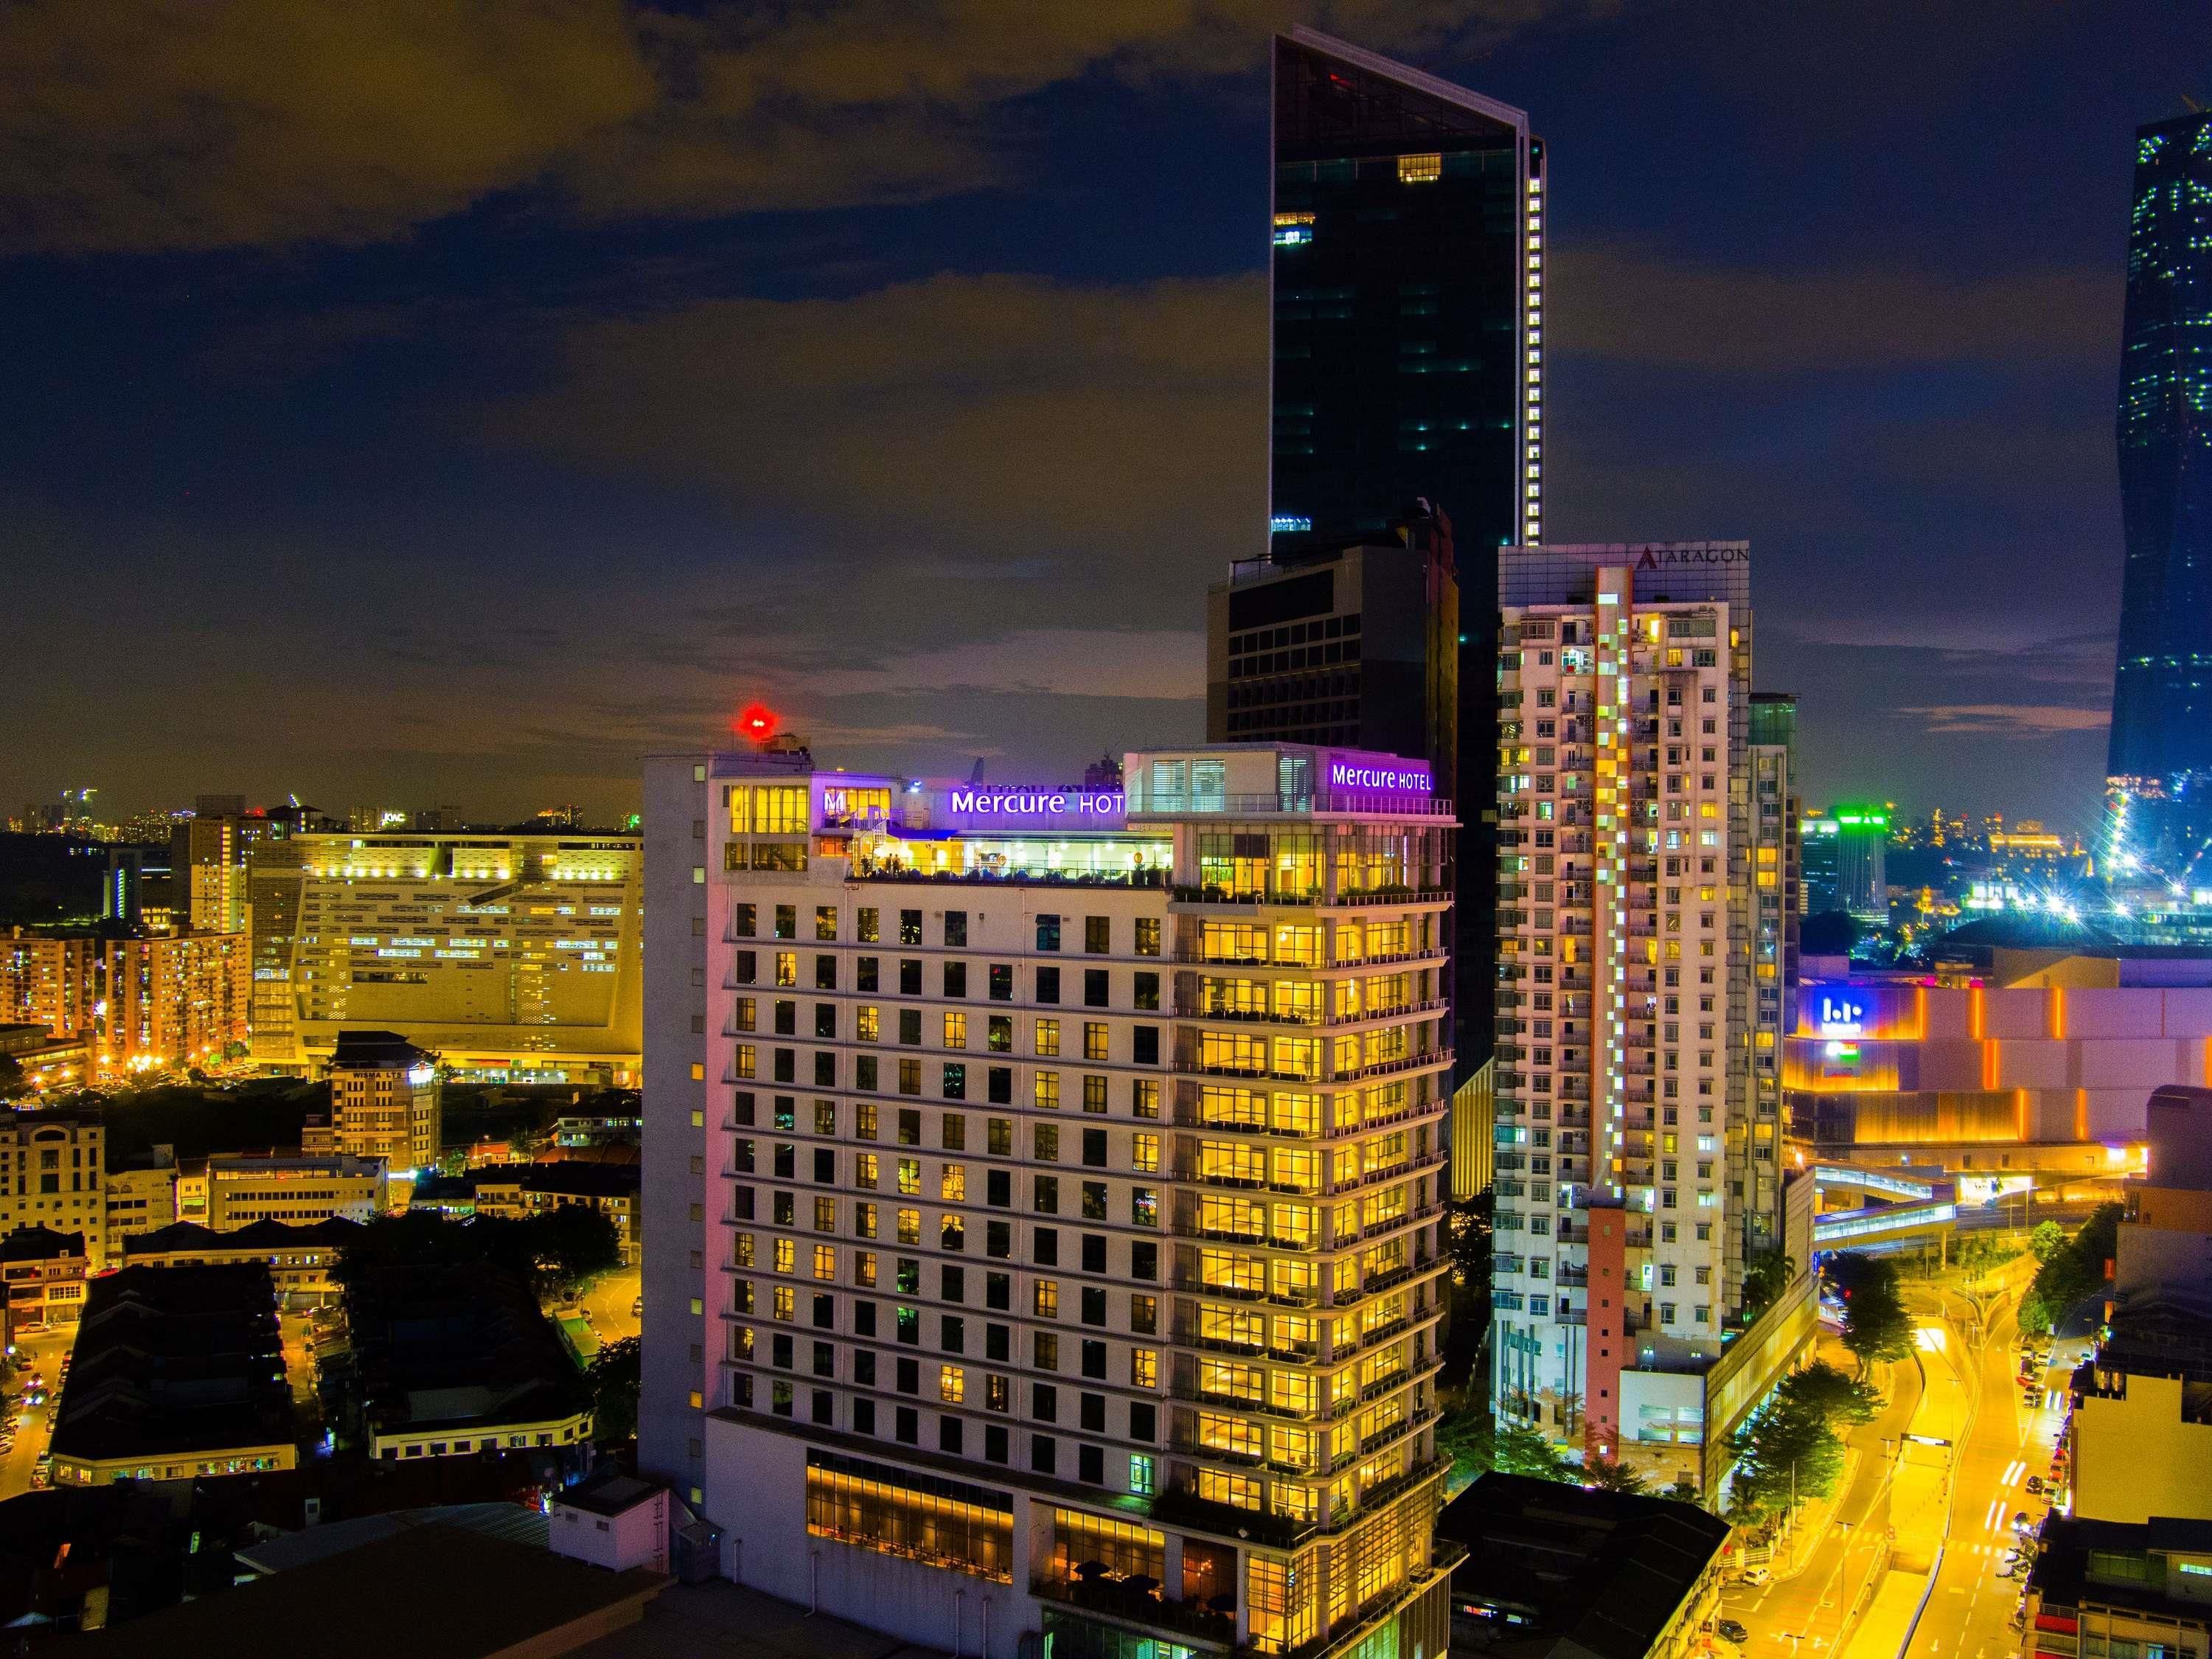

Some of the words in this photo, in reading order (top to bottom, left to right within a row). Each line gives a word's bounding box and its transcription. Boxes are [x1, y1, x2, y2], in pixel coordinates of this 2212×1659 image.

[1333, 765, 1395, 788] Mercure
[1399, 773, 1431, 790] HOTEL
[952, 792, 1065, 813] Mercure
